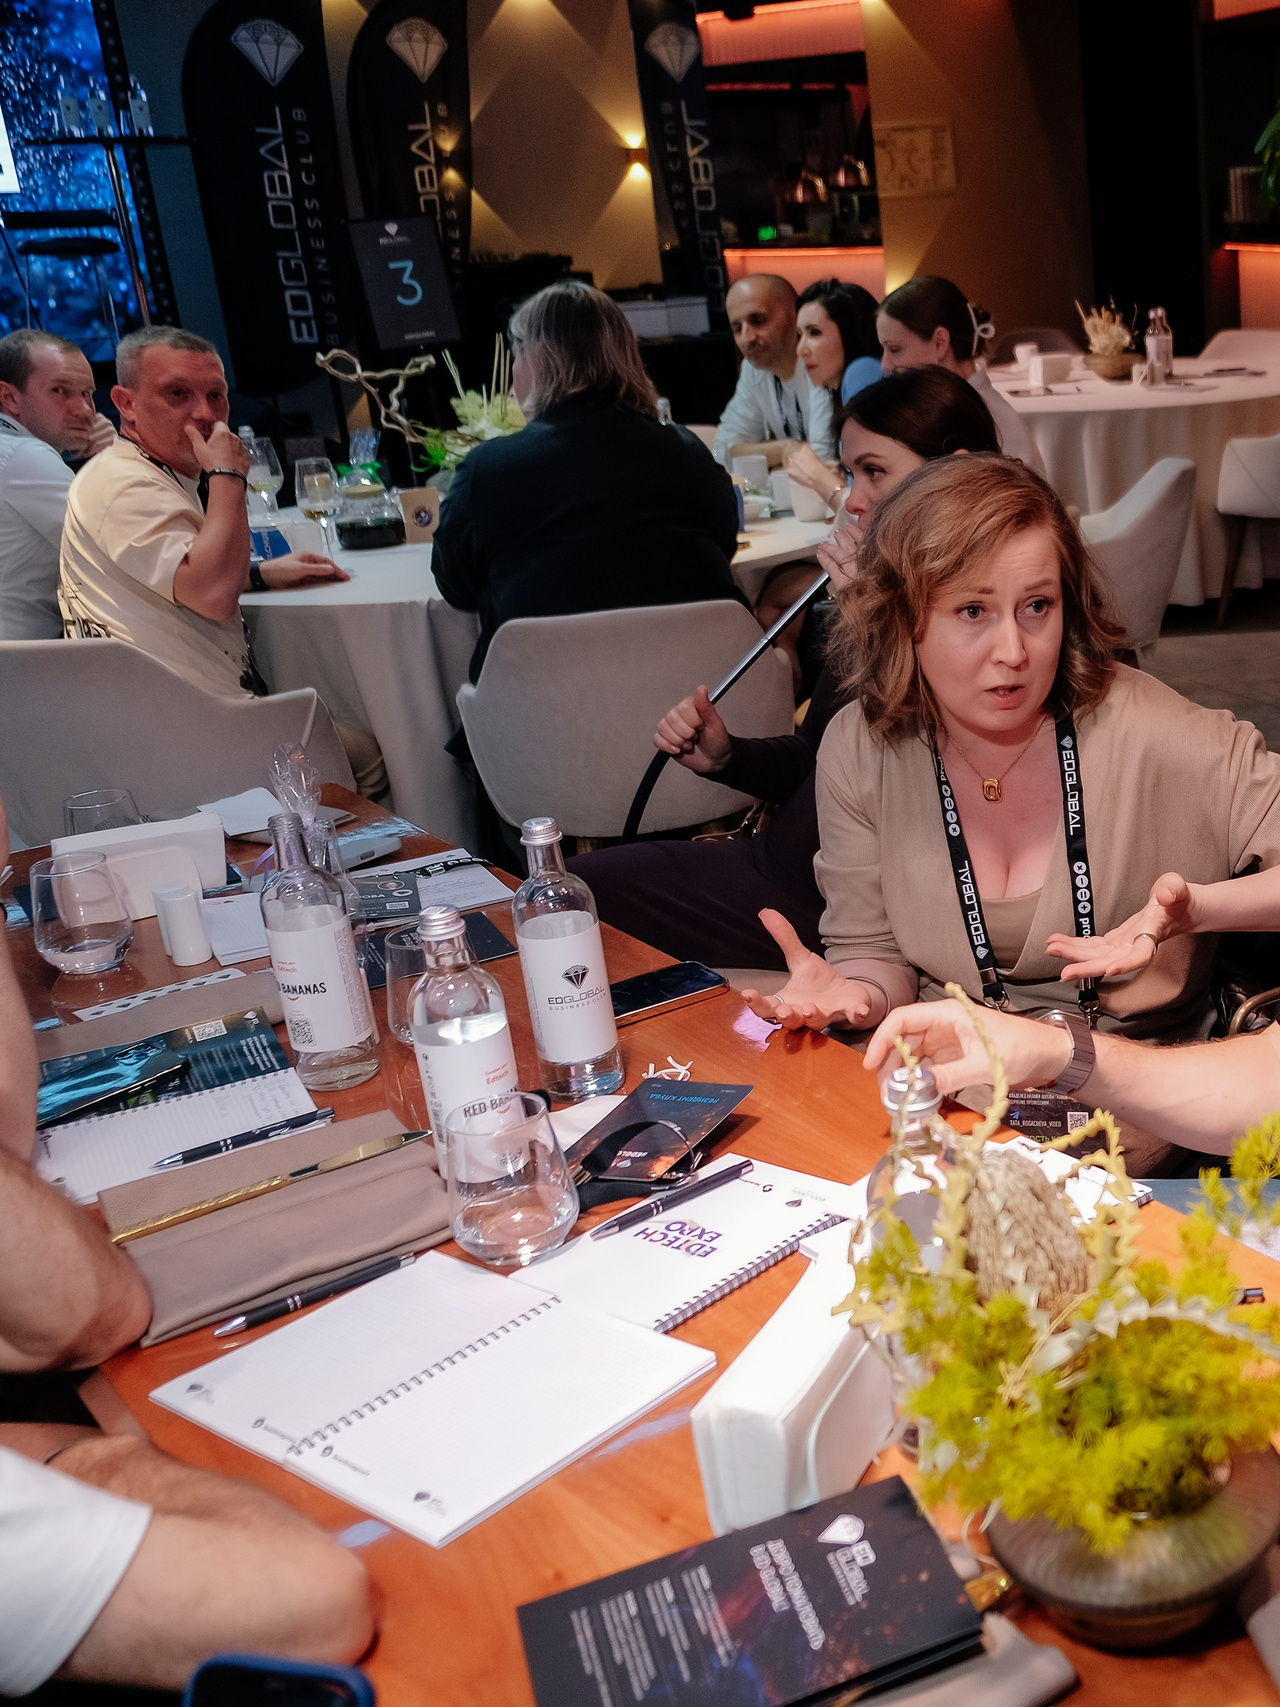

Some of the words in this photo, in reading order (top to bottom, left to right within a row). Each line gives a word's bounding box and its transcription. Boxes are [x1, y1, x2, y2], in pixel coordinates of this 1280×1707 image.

[291, 106, 316, 187] CLUB
[407, 101, 444, 241] OBAL
[255, 104, 319, 345] EDGLOBAL
[304, 197, 340, 346] BUSINESS
[387, 259, 424, 307] 3
[1062, 749, 1081, 836] EDGLOBAL
[958, 860, 987, 946] EDGLOBAL
[281, 982, 327, 995] BANANAS
[547, 985, 606, 1005] EDGLOBAL
[549, 1001, 590, 1011] BUSINESS
[463, 1102, 487, 1119] RED
[650, 1093, 676, 1102] КЛУБА
[676, 1095, 721, 1104] РЕЗИДЕНТ
[633, 1227, 719, 1258] EDTECH
[664, 1220, 723, 1243] EXPO
[851, 1539, 877, 1567] ED
